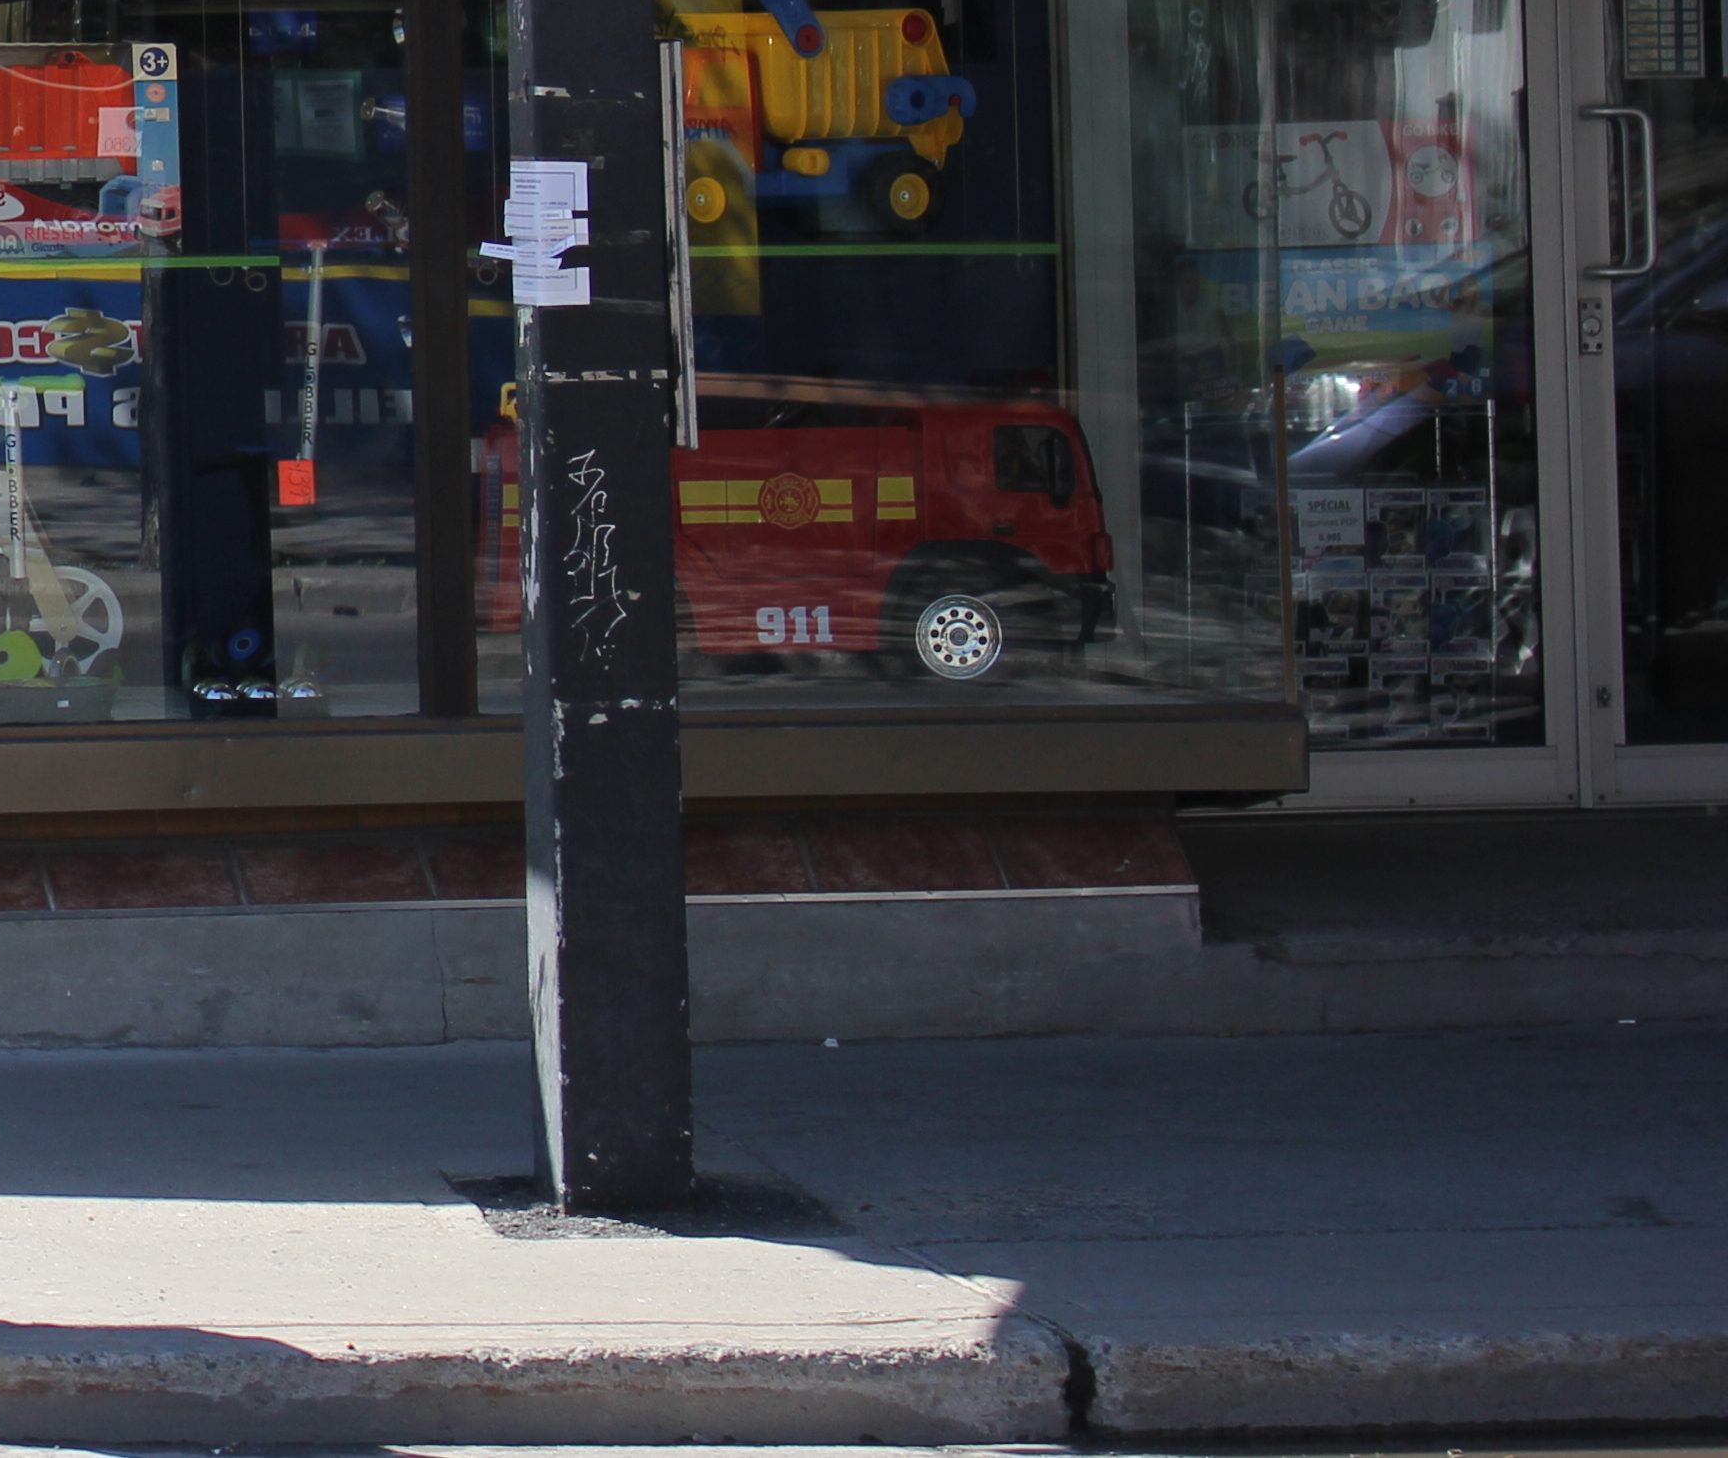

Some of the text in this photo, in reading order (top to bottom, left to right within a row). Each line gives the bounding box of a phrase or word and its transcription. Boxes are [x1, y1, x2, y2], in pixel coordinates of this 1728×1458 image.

[140, 50, 169, 73] 3+
[1218, 276, 1347, 319] BEAN
[1305, 314, 1370, 335] GAME
[4, 433, 22, 543] GLOBBER
[1307, 497, 1353, 512] SPÉCIAL
[756, 605, 834, 644] 911
